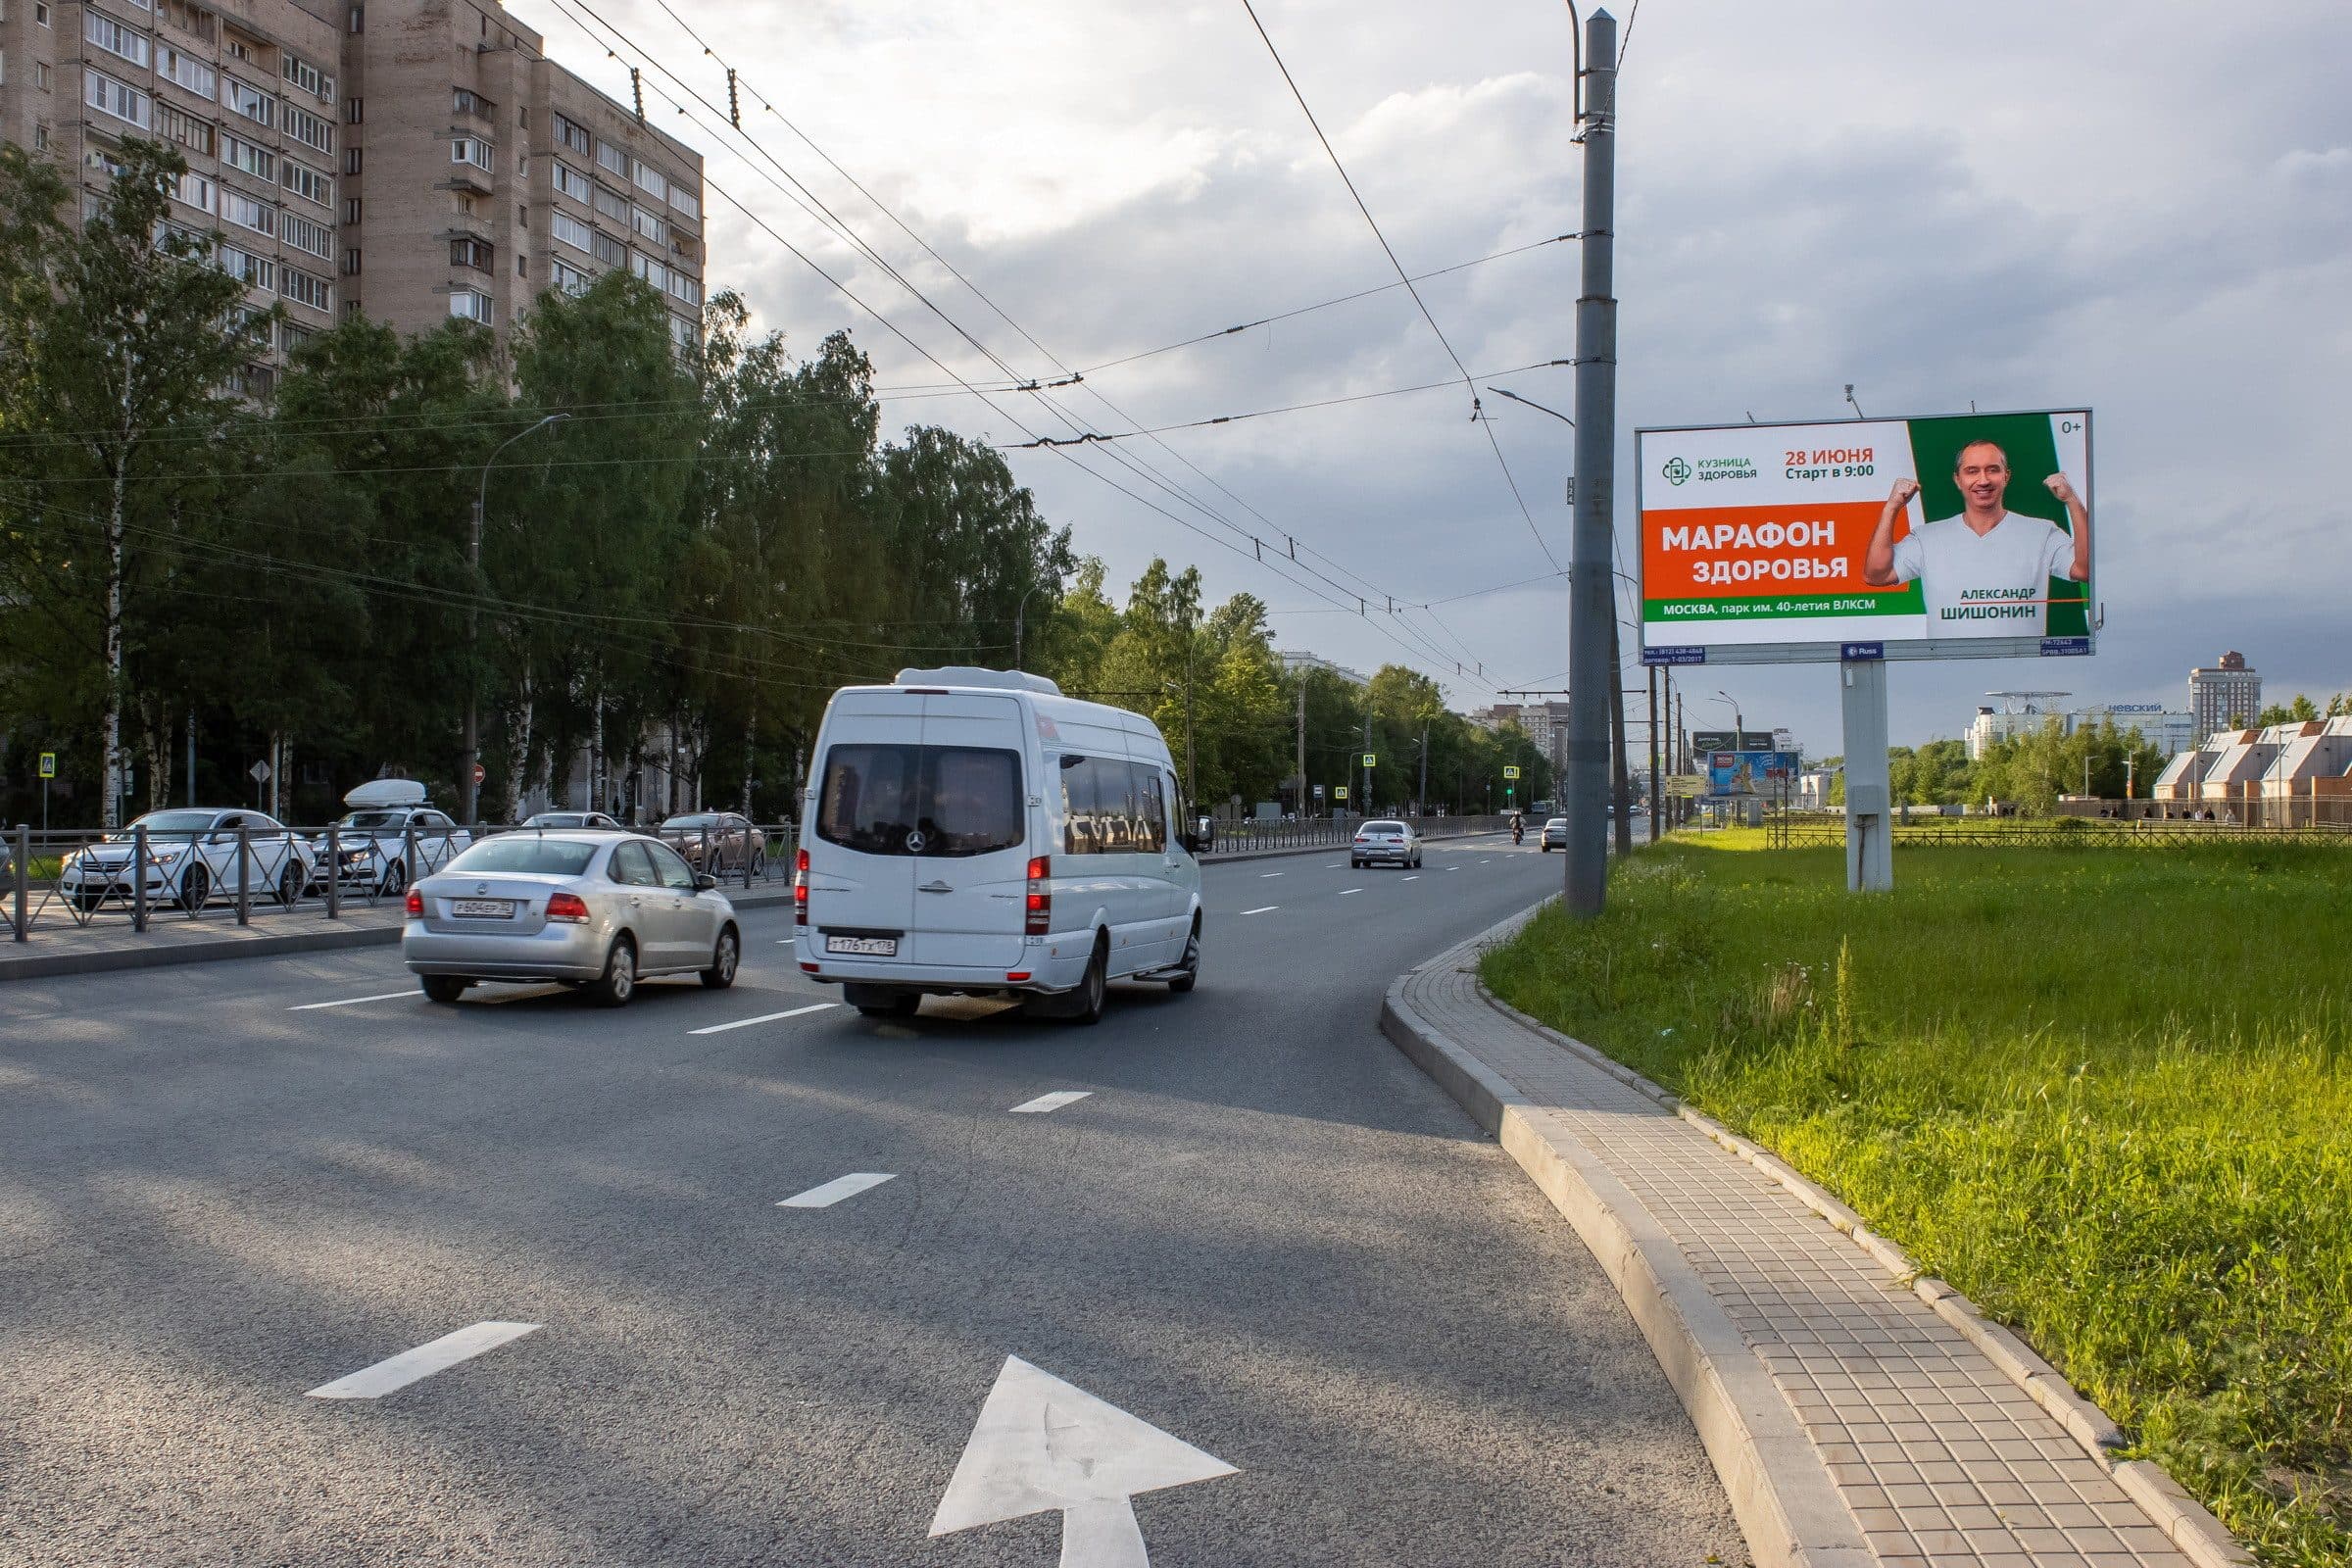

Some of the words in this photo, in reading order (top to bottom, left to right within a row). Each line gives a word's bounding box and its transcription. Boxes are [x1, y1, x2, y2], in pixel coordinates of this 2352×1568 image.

[2061, 421, 2082, 434] 0+
[1697, 457, 1751, 468] КУЗНИЦА
[1785, 450, 1807, 466] 28
[1812, 448, 1874, 465] ИЮНЯ
[1697, 469, 1757, 481] ЗДОРОВЬЯ
[1786, 467, 1827, 481] Старт
[1832, 466, 1840, 477] в
[1844, 465, 1874, 477] 9:00
[1662, 520, 1836, 551] МАРАФОН
[1692, 557, 1848, 585] ЗДОРОВЬЯ
[1961, 588, 2036, 600] АЛЕКСАНДР
[1663, 604, 1718, 615] МОСКВА,
[1722, 604, 1750, 615] парк
[1753, 603, 1773, 612] им.
[1777, 601, 1830, 612] 40-летия
[1834, 599, 1876, 611] ВЛКСМ
[1940, 606, 2036, 620] ШИШОНИН
